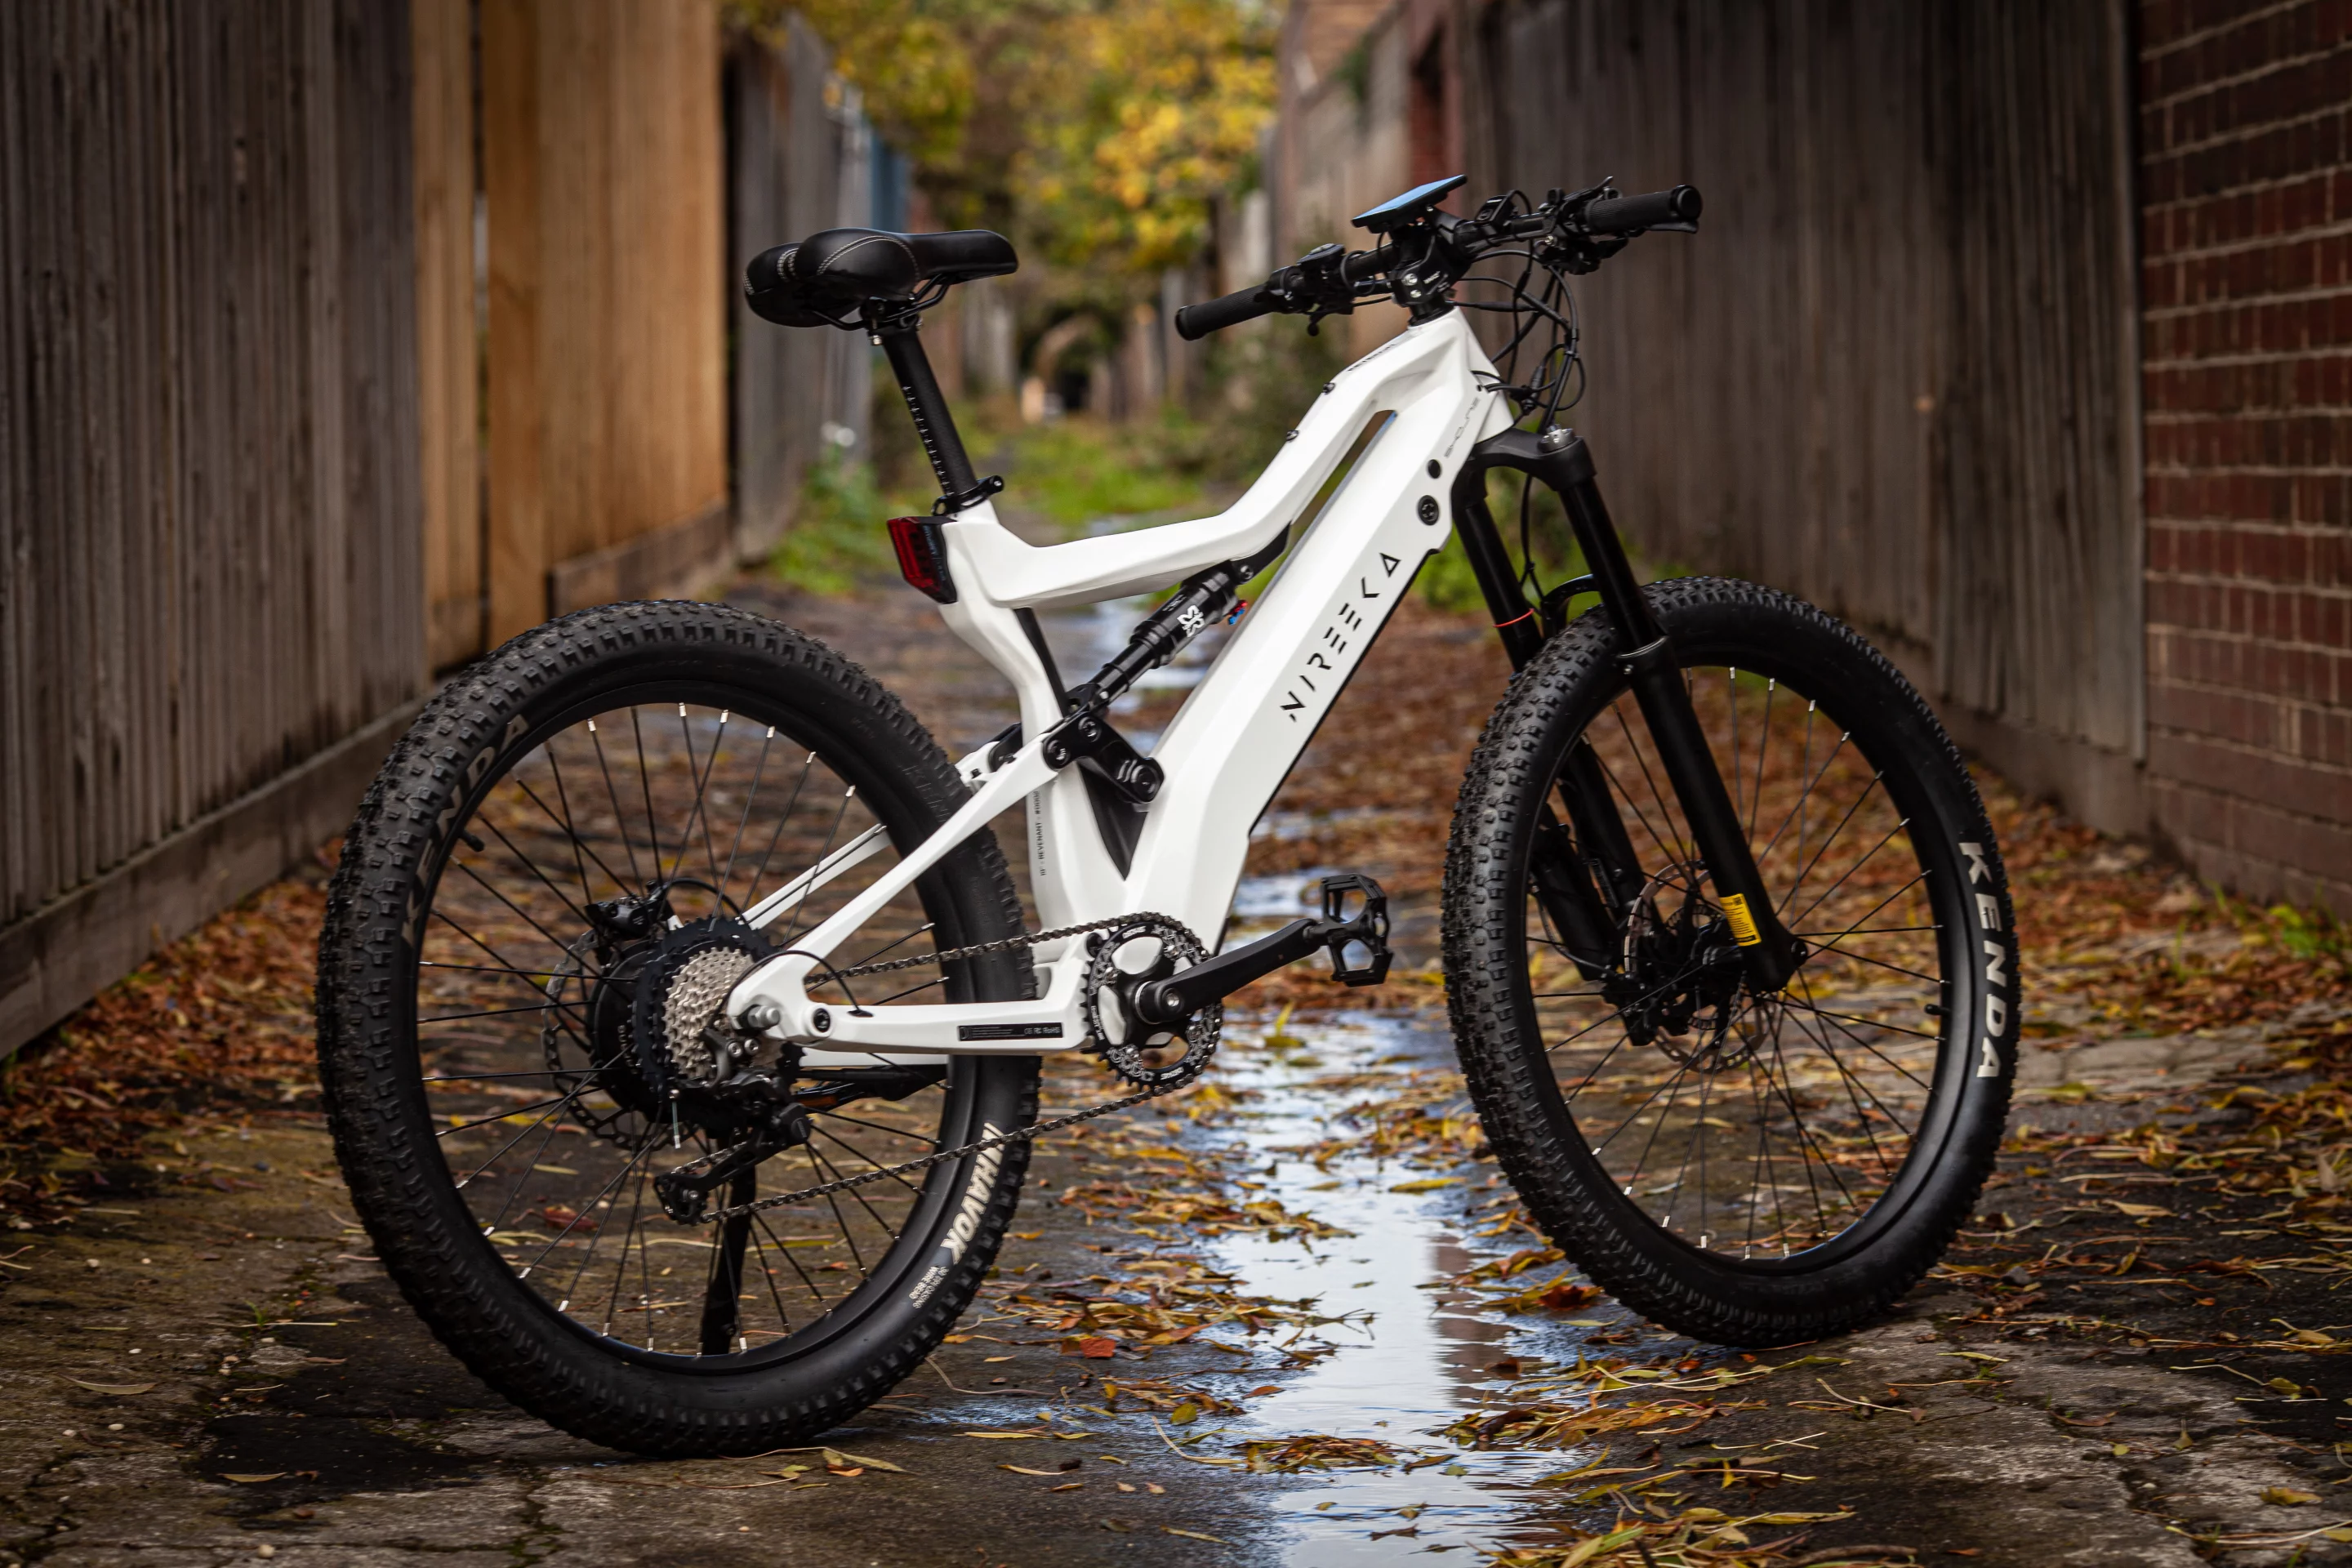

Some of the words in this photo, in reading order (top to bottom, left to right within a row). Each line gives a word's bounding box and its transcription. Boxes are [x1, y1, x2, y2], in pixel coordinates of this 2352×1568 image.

[1279, 552, 1401, 723] NIREEKA
[400, 713, 530, 948] KENDA
[1035, 822, 1046, 860] REVENANT
[1958, 842, 2007, 1078] KENDA
[940, 1152, 1000, 1265] HAVOK
[908, 1281, 928, 1299] BEAD
